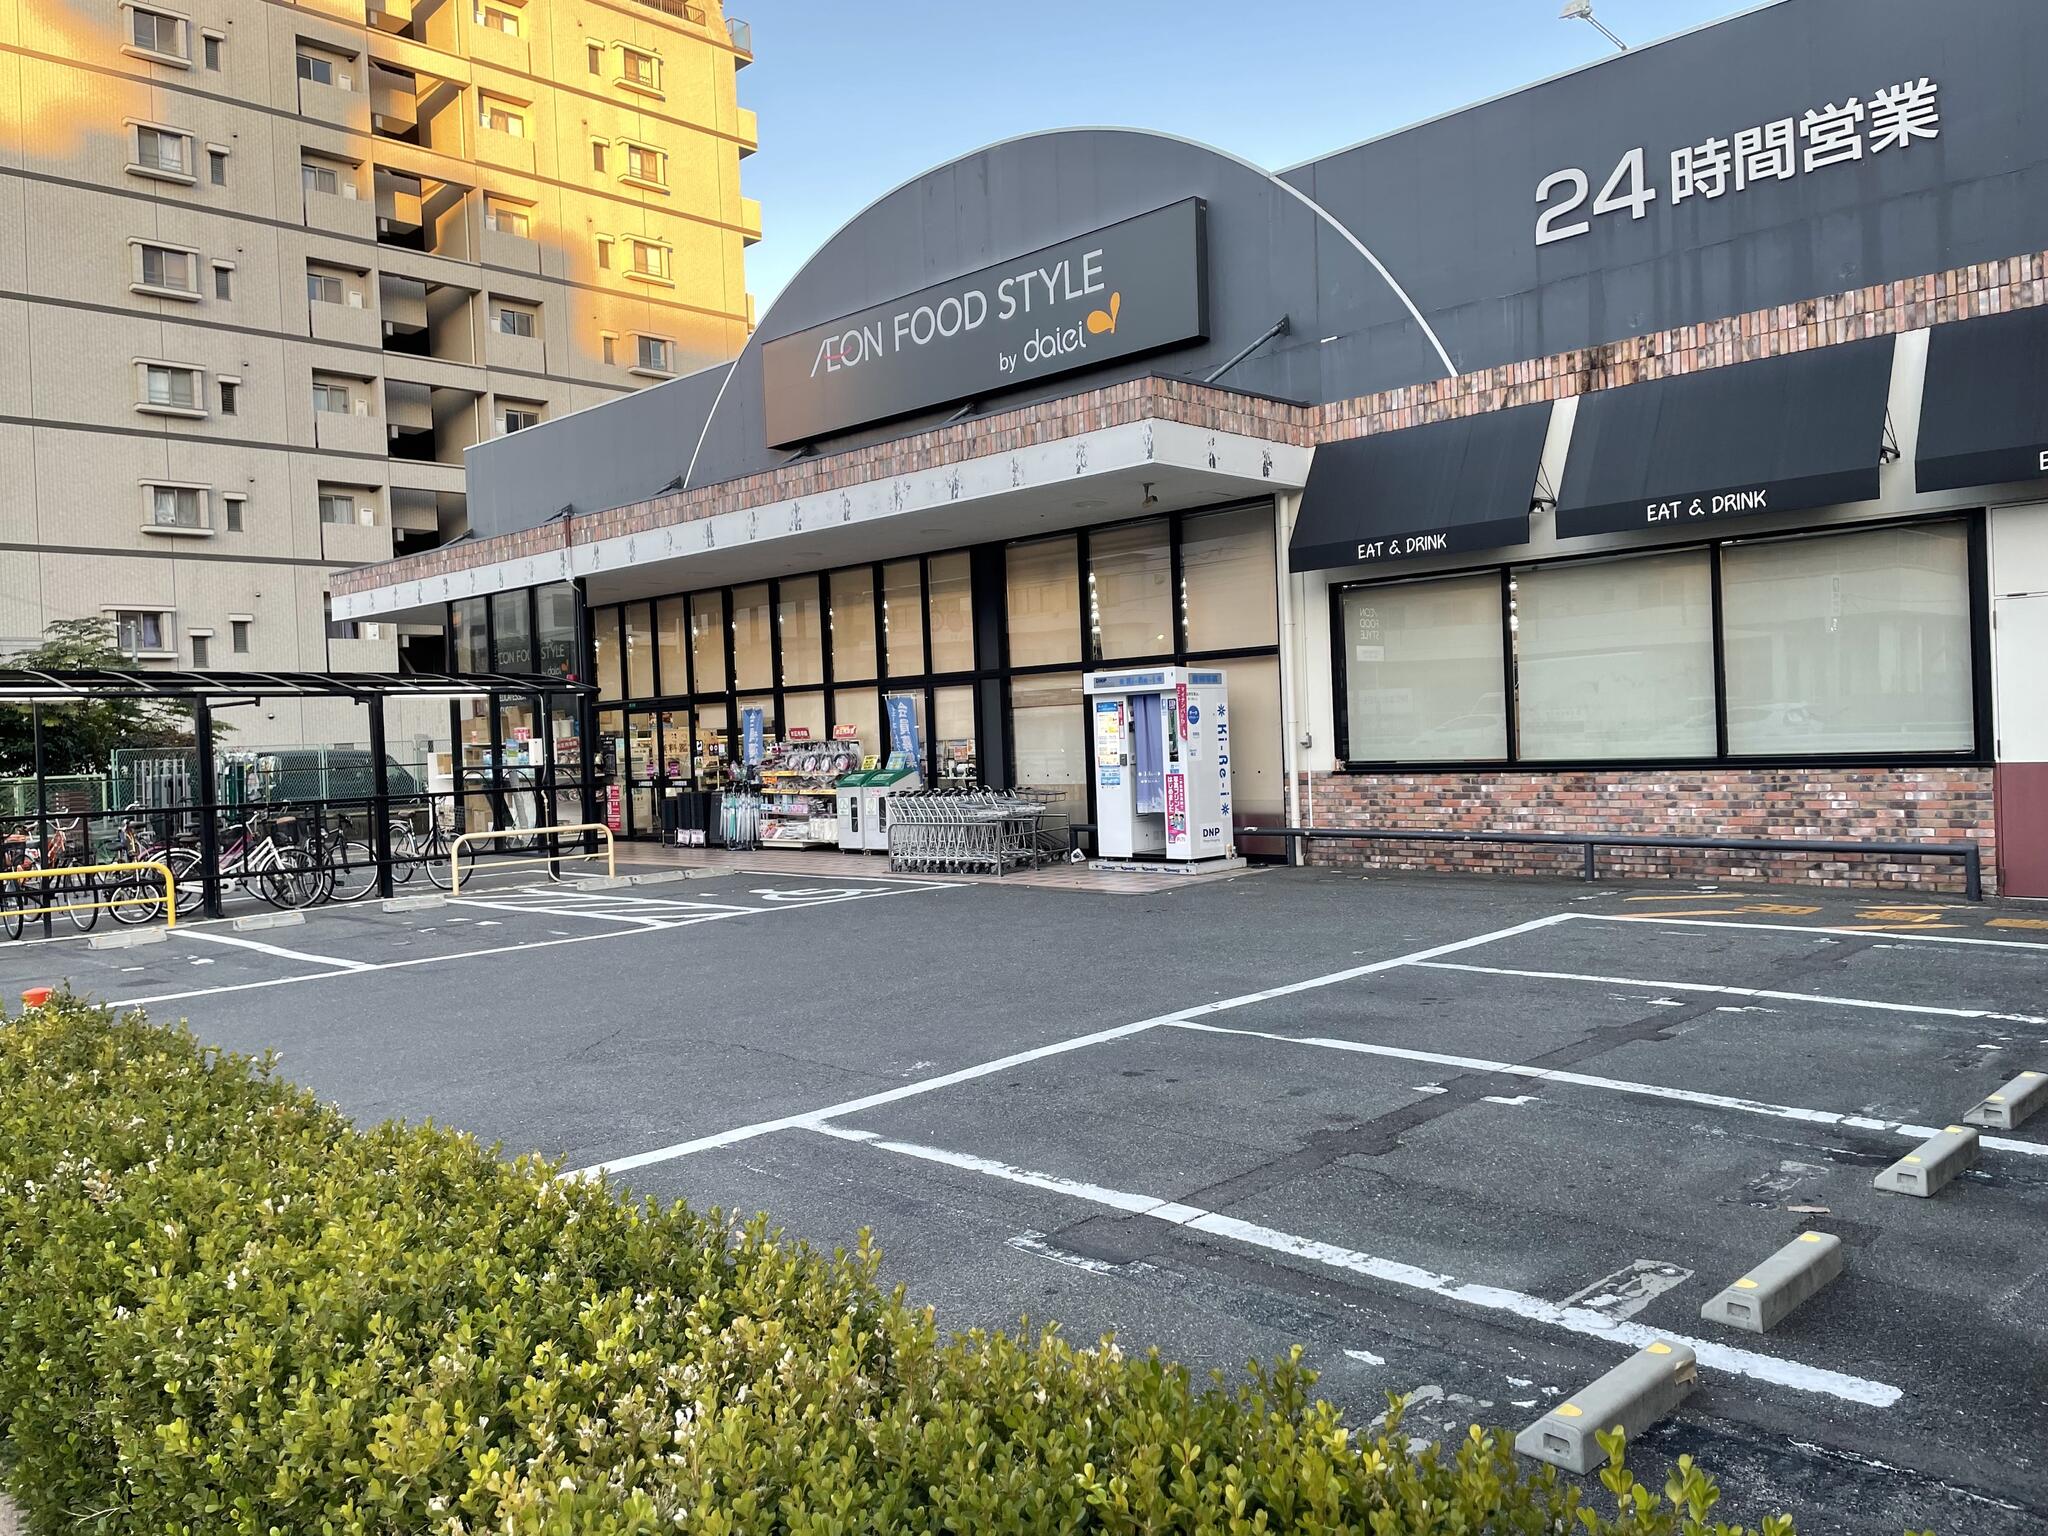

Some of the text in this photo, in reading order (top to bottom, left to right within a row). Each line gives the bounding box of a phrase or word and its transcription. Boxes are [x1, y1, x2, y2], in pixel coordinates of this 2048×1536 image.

[894, 290, 988, 352] FOOD
[998, 249, 1106, 320] STYLE
[1000, 320, 1087, 374] by daiei
[1647, 489, 1767, 522] EAT & DRINK
[1358, 533, 1447, 559] EAT & DRINK
[1203, 827, 1220, 837] DNP
